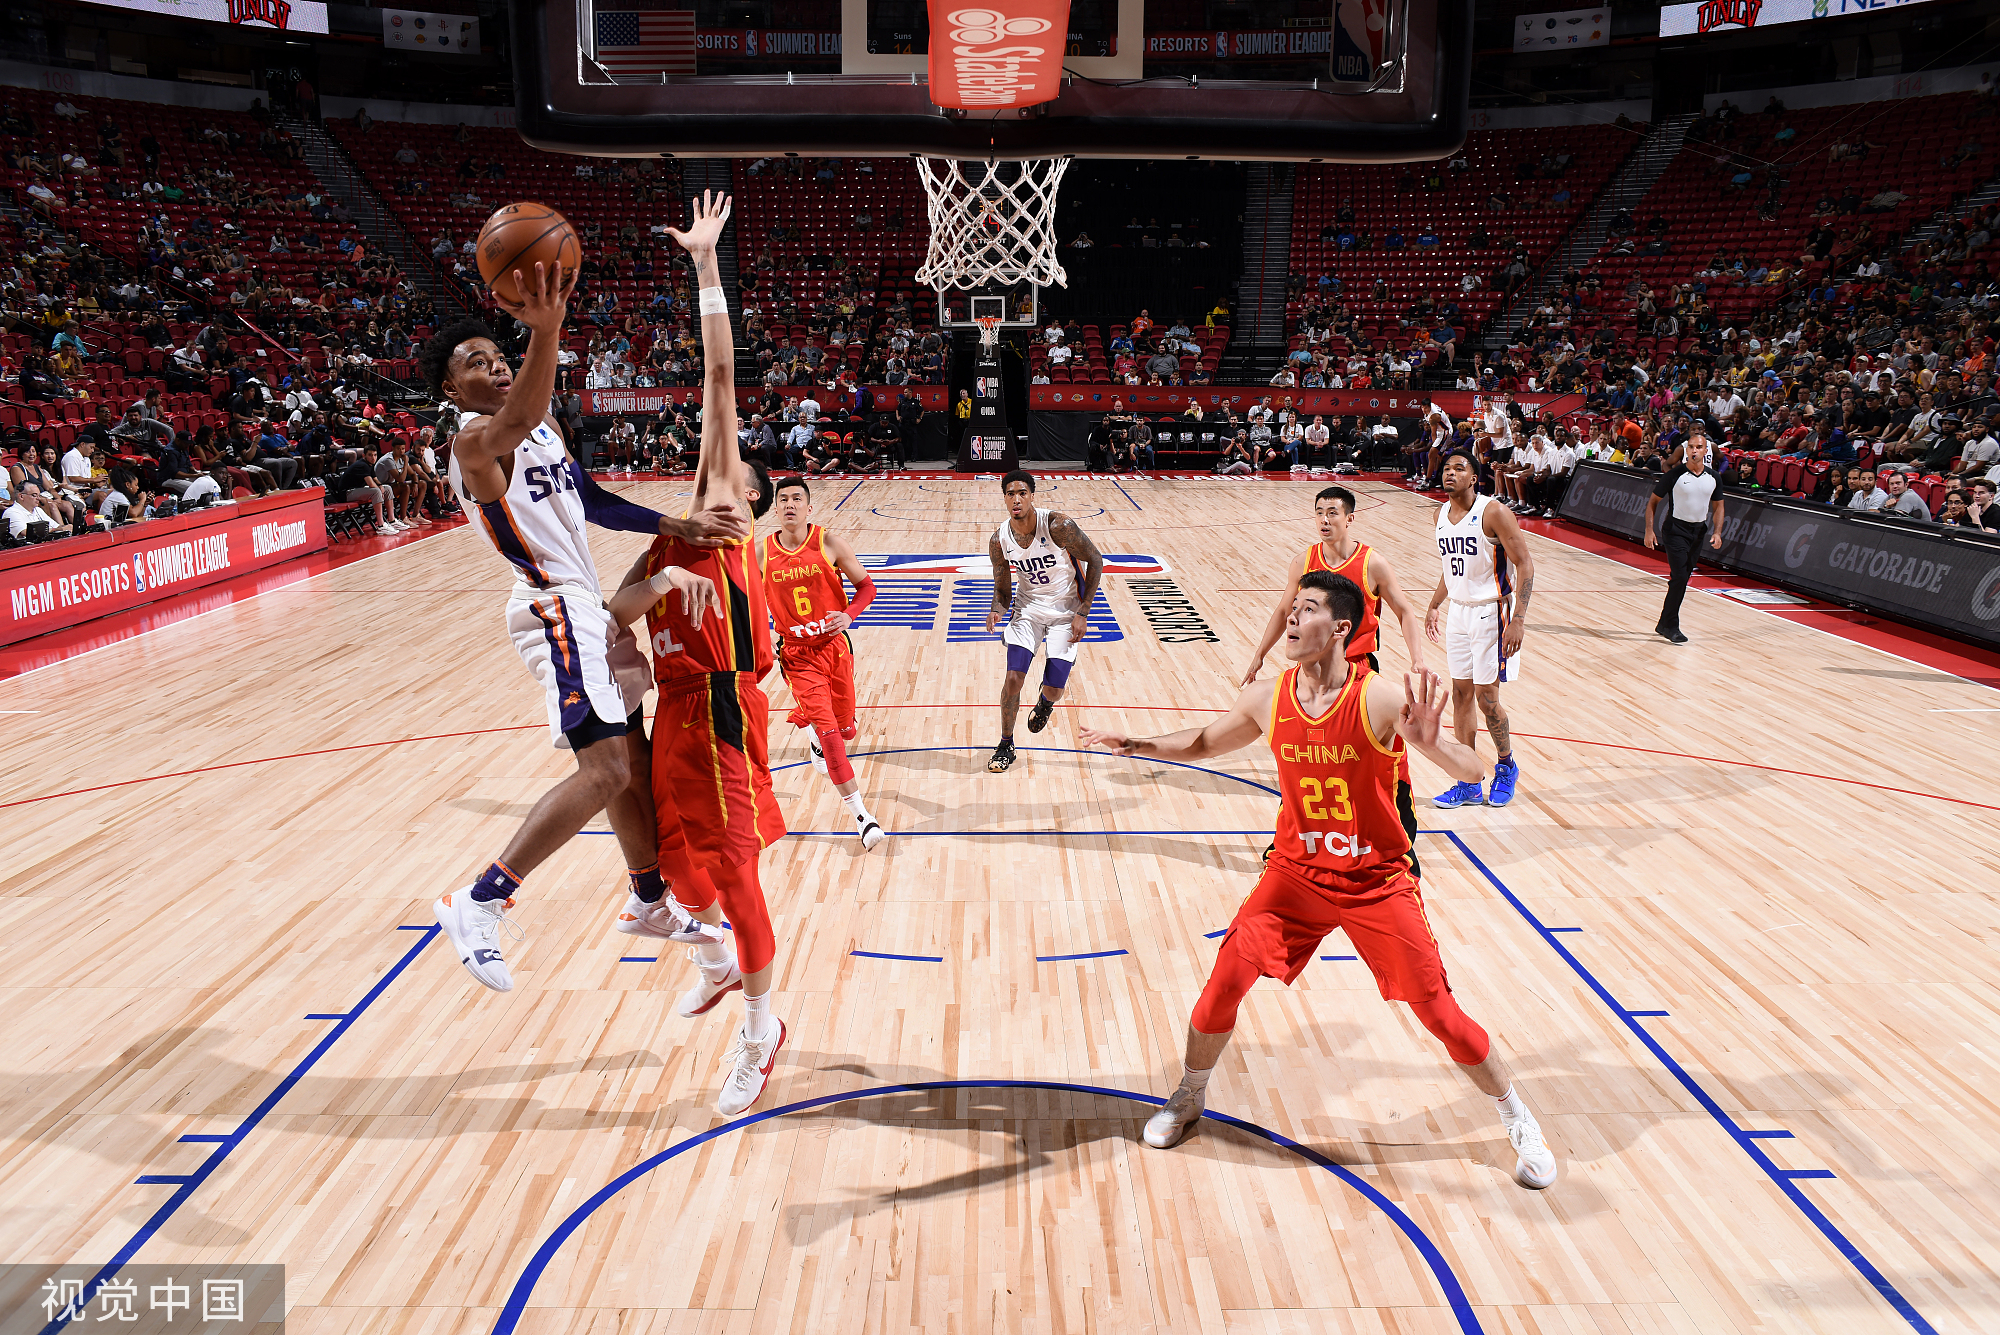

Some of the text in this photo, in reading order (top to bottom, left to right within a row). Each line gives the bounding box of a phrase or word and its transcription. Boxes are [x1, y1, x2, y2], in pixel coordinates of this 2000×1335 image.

[226, 0, 291, 30] UNLV
[1697, 0, 1762, 33] UNLV
[696, 35, 738, 50] SORTS
[765, 32, 816, 55] SUMMER
[893, 32, 912, 40] Suns
[1150, 37, 1209, 52] RESORTS
[1235, 32, 1286, 55] SUMMER
[1338, 55, 1364, 76] NBA
[43, 71, 75, 91] 109
[1895, 76, 1922, 96] 114
[986, 377, 999, 388] NBA
[986, 387, 998, 399] App
[602, 397, 636, 413] SUMMER
[983, 440, 1006, 451] SUMMER
[983, 450, 1003, 461] LEAGUE
[252, 519, 307, 558] #NBASummer
[10, 532, 231, 620] MGM RESORTS SUMMER LEAGUE
[772, 564, 823, 583] CHINA
[1028, 571, 1050, 585] 26
[1828, 541, 1952, 594] GATORADE
[1125, 579, 1184, 597] MGM
[792, 586, 812, 616] 6
[1139, 599, 1221, 644] RESORTS
[652, 627, 684, 658] CL
[1280, 743, 1361, 764] CHINA
[1299, 776, 1354, 821] 23
[1298, 831, 1372, 858] TCL
